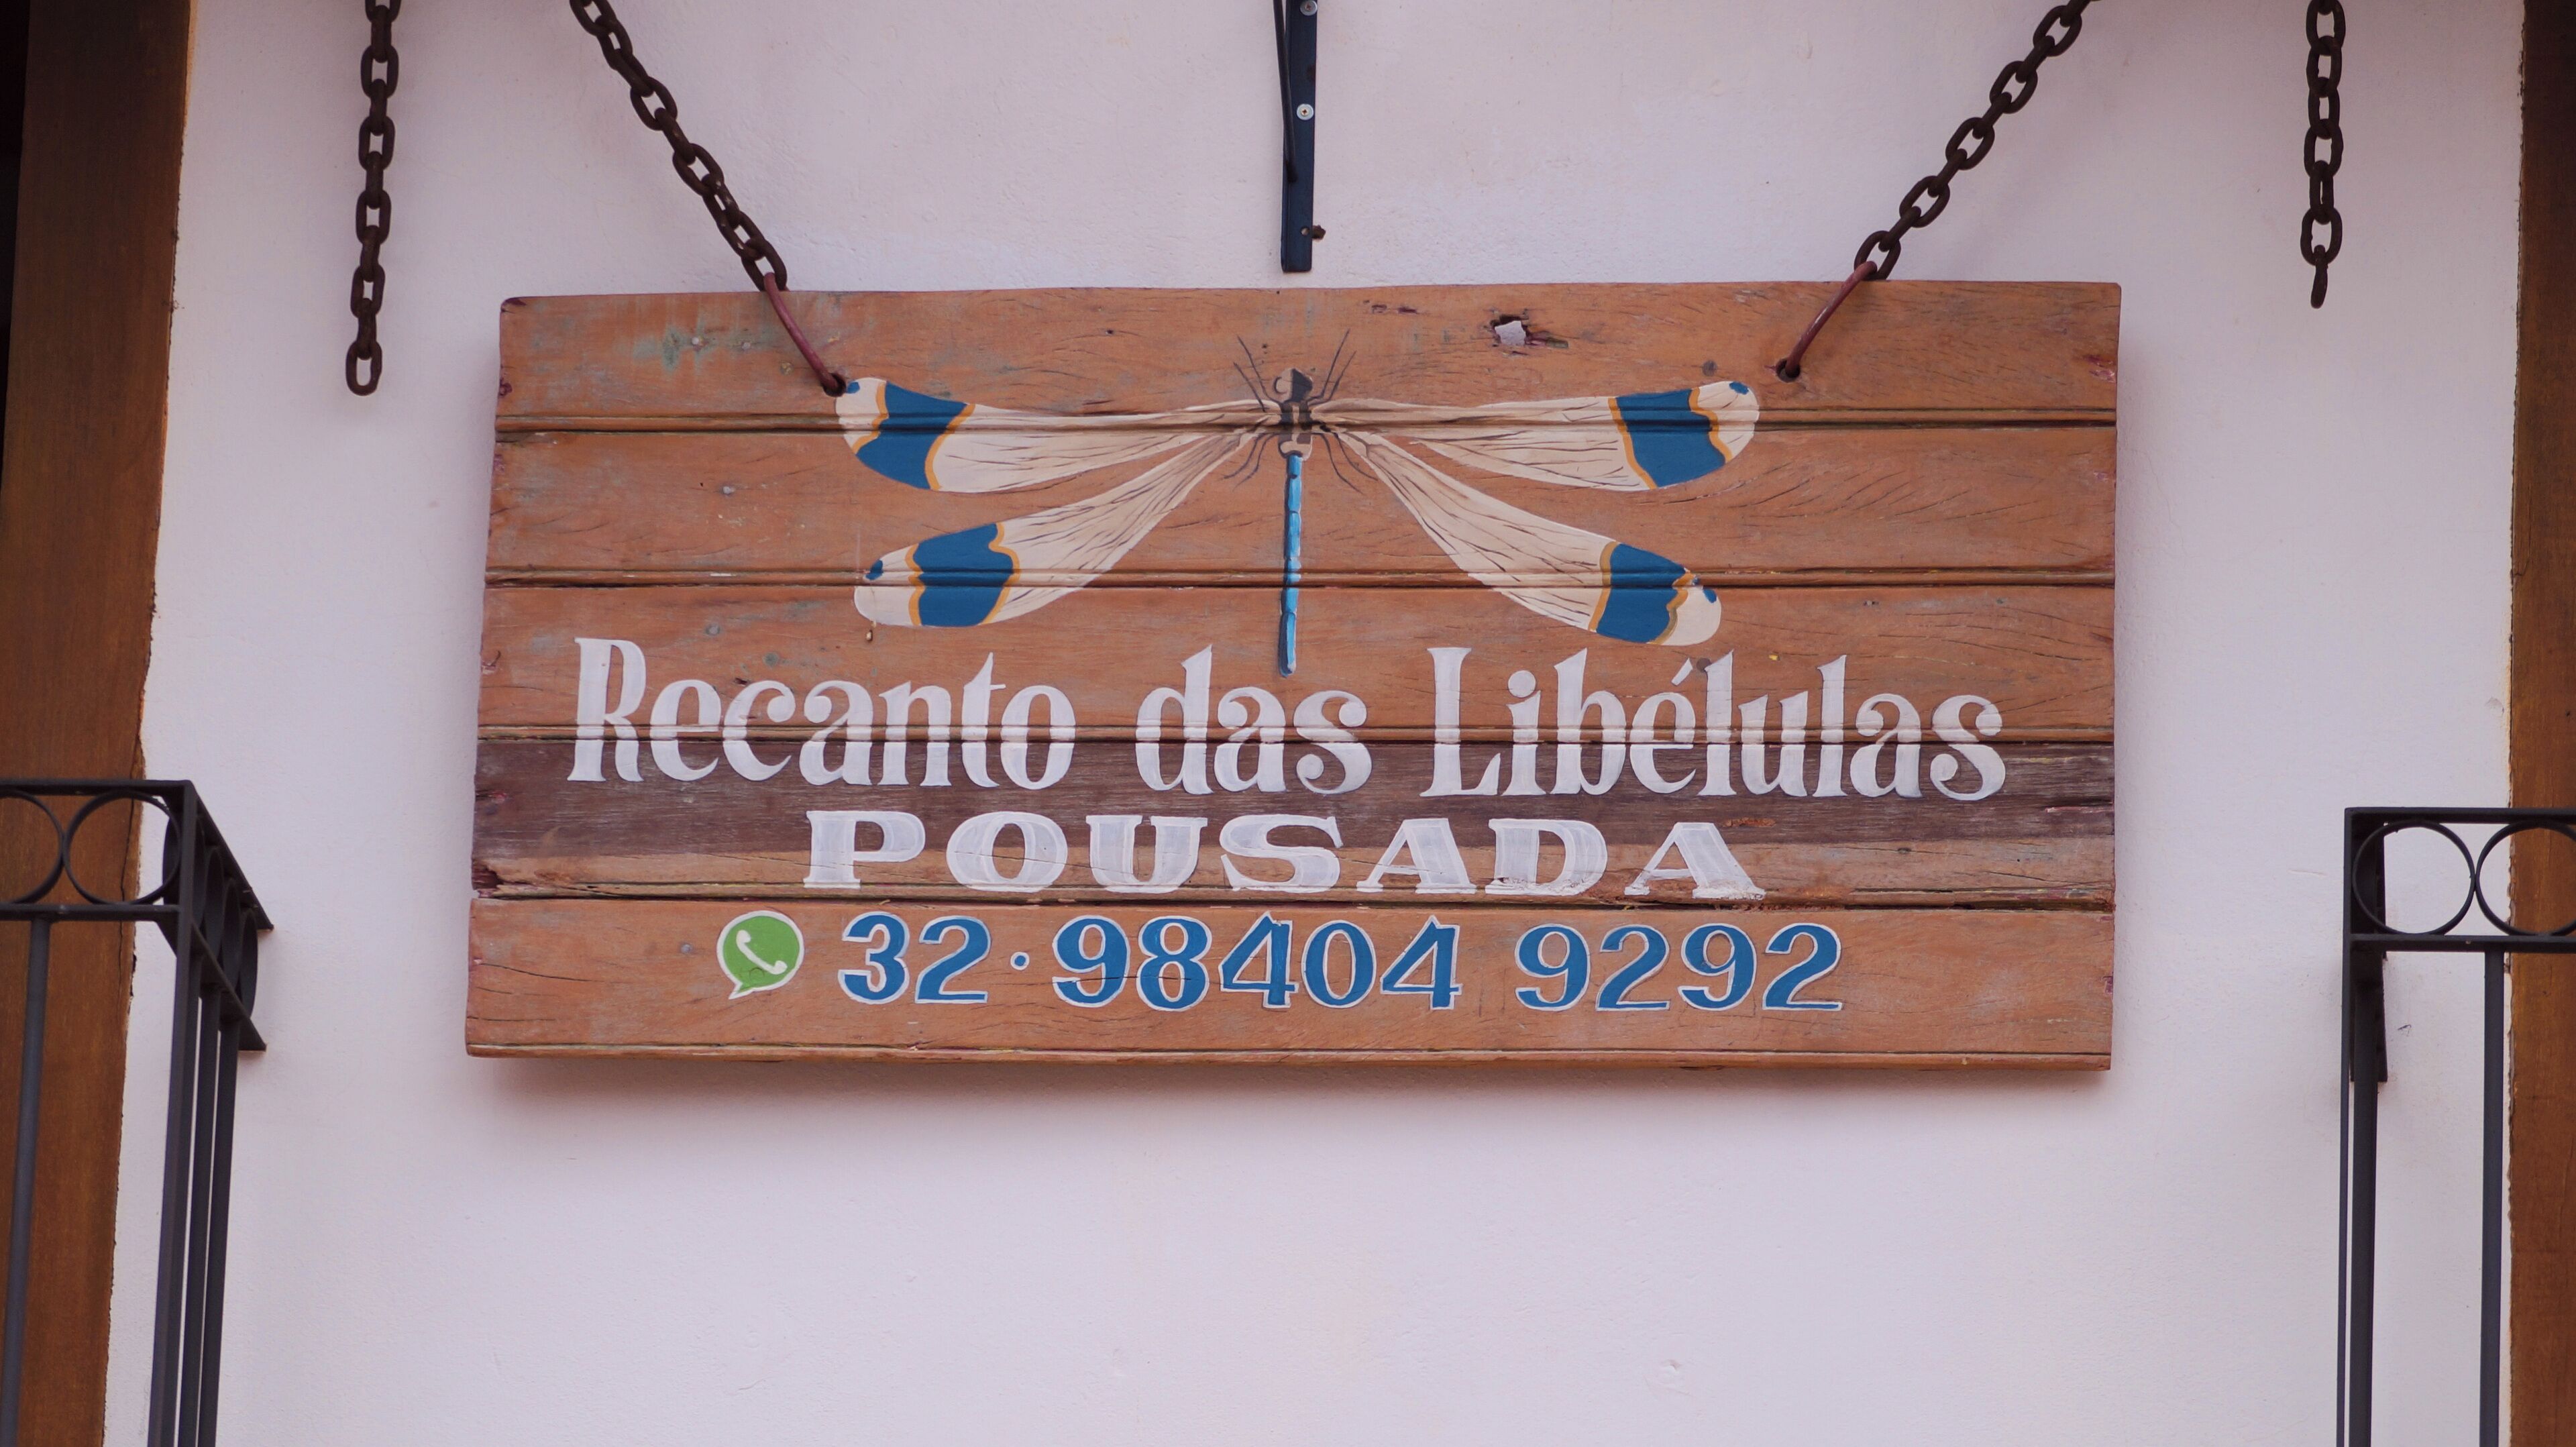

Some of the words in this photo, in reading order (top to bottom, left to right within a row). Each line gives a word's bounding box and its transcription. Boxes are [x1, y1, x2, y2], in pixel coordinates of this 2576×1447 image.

[567, 637, 1076, 790] Recanto
[1135, 644, 1373, 794] das
[1419, 647, 2006, 801] Libélulas
[803, 810, 1766, 900] POUSADA
[1514, 922, 1843, 1012] 9292
